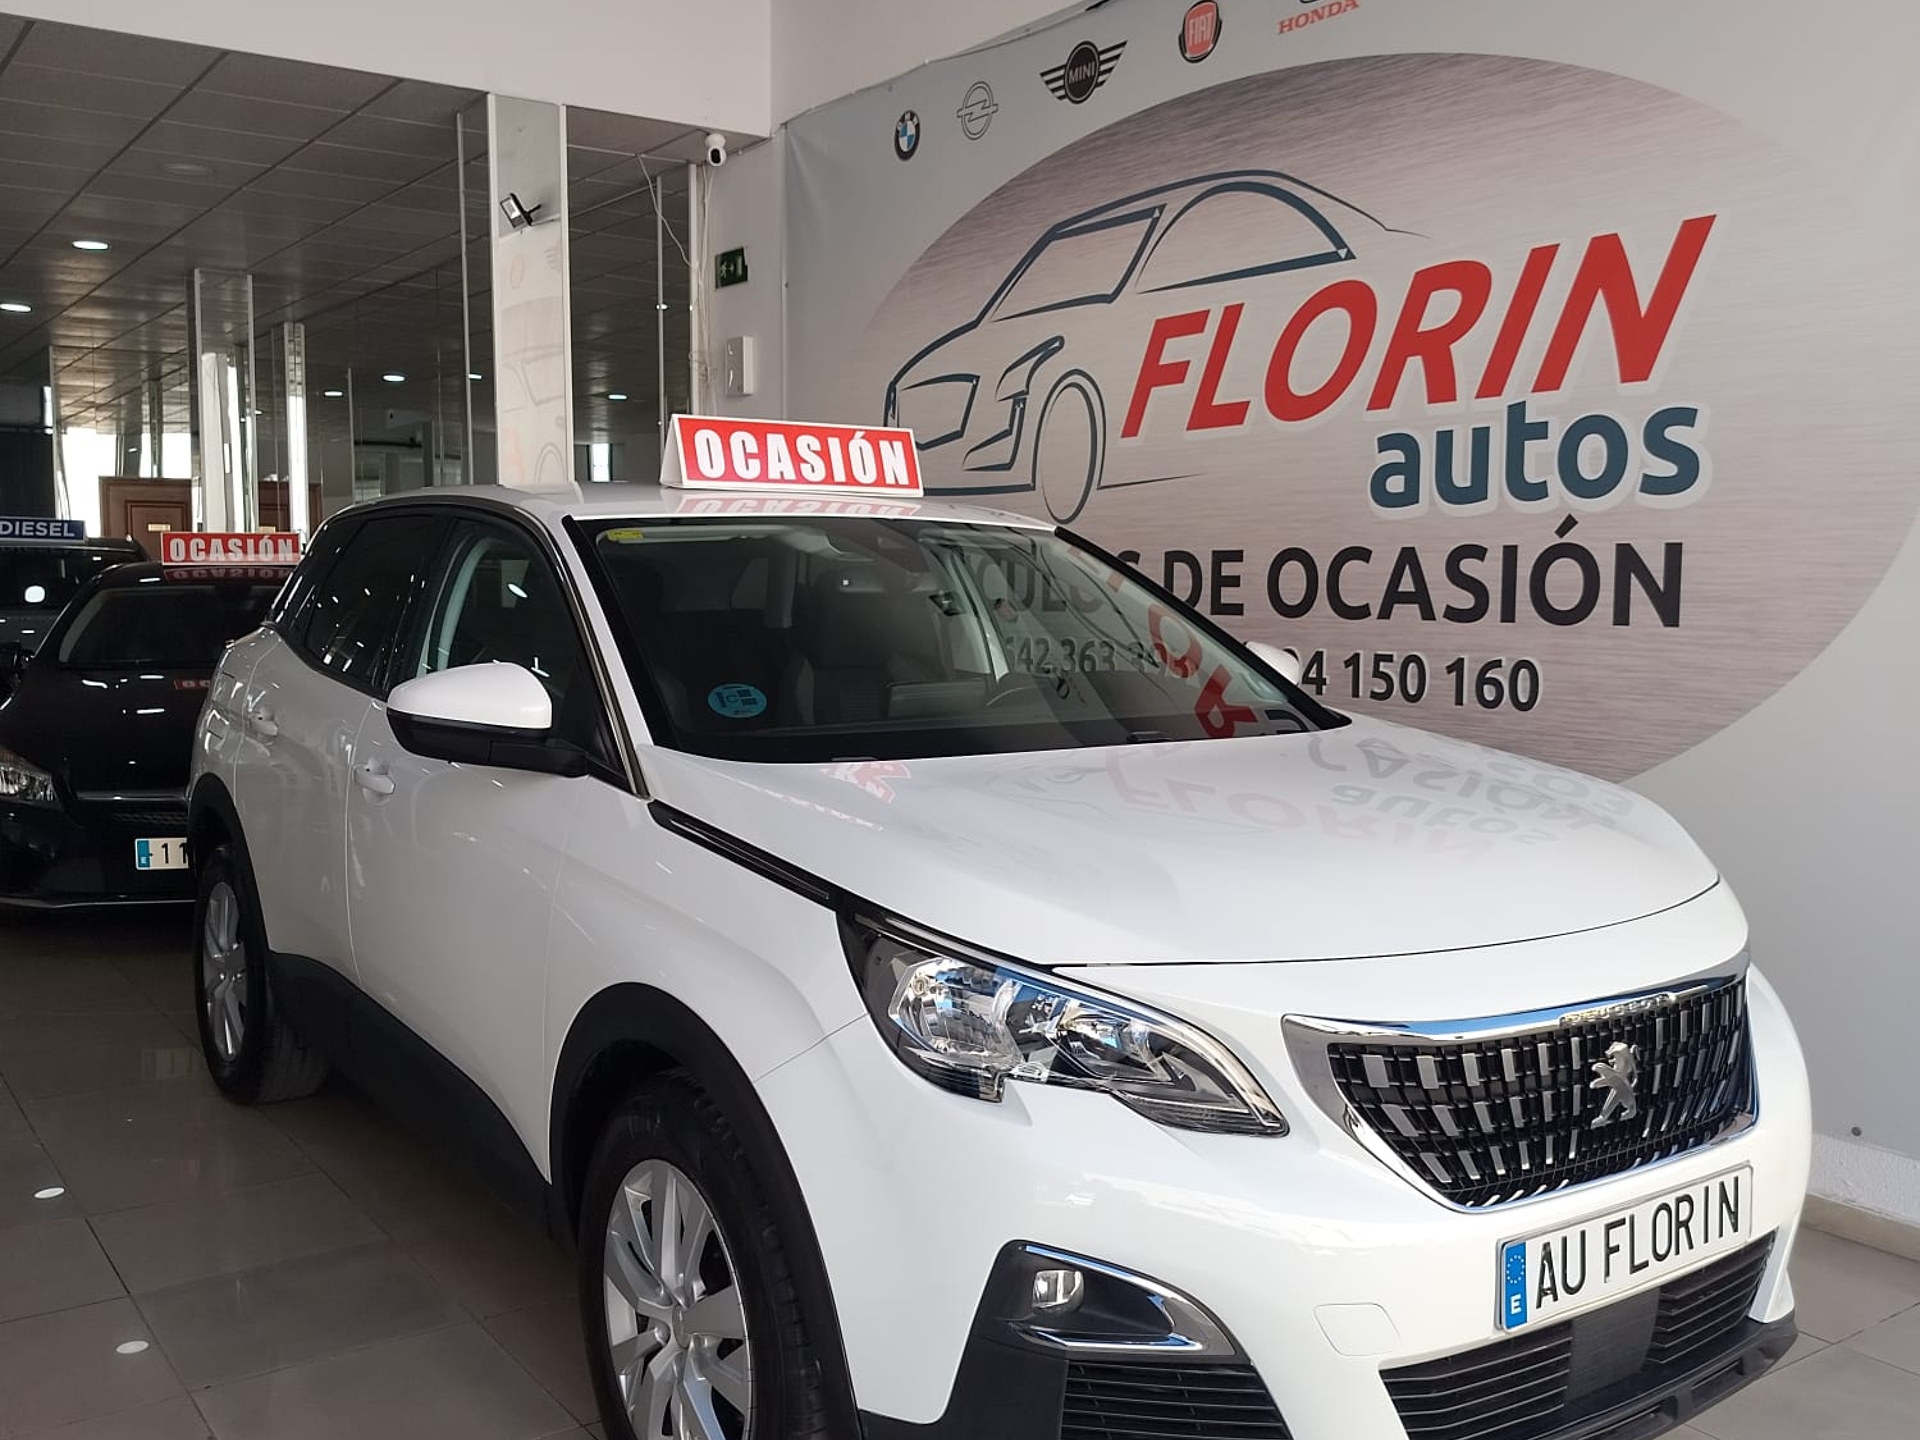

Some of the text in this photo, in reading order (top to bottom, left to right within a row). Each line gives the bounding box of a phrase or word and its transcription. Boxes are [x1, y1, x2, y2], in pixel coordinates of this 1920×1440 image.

[1188, 12, 1214, 46] FIAT
[1278, 0, 1359, 34] HONDA
[1068, 61, 1095, 84] MINI
[1121, 214, 1716, 438] FLORIN
[694, 429, 910, 485] OCASIÓN
[1369, 400, 1700, 508] autos
[0, 521, 75, 537] DIESEL
[170, 535, 293, 562] OCASIÓN
[1163, 550, 1244, 616] DE
[1267, 514, 1683, 627] OCASIÓN
[1343, 652, 1427, 703] 150
[1445, 656, 1540, 711] 160
[1510, 1175, 1739, 1314] E AU FLORIN
